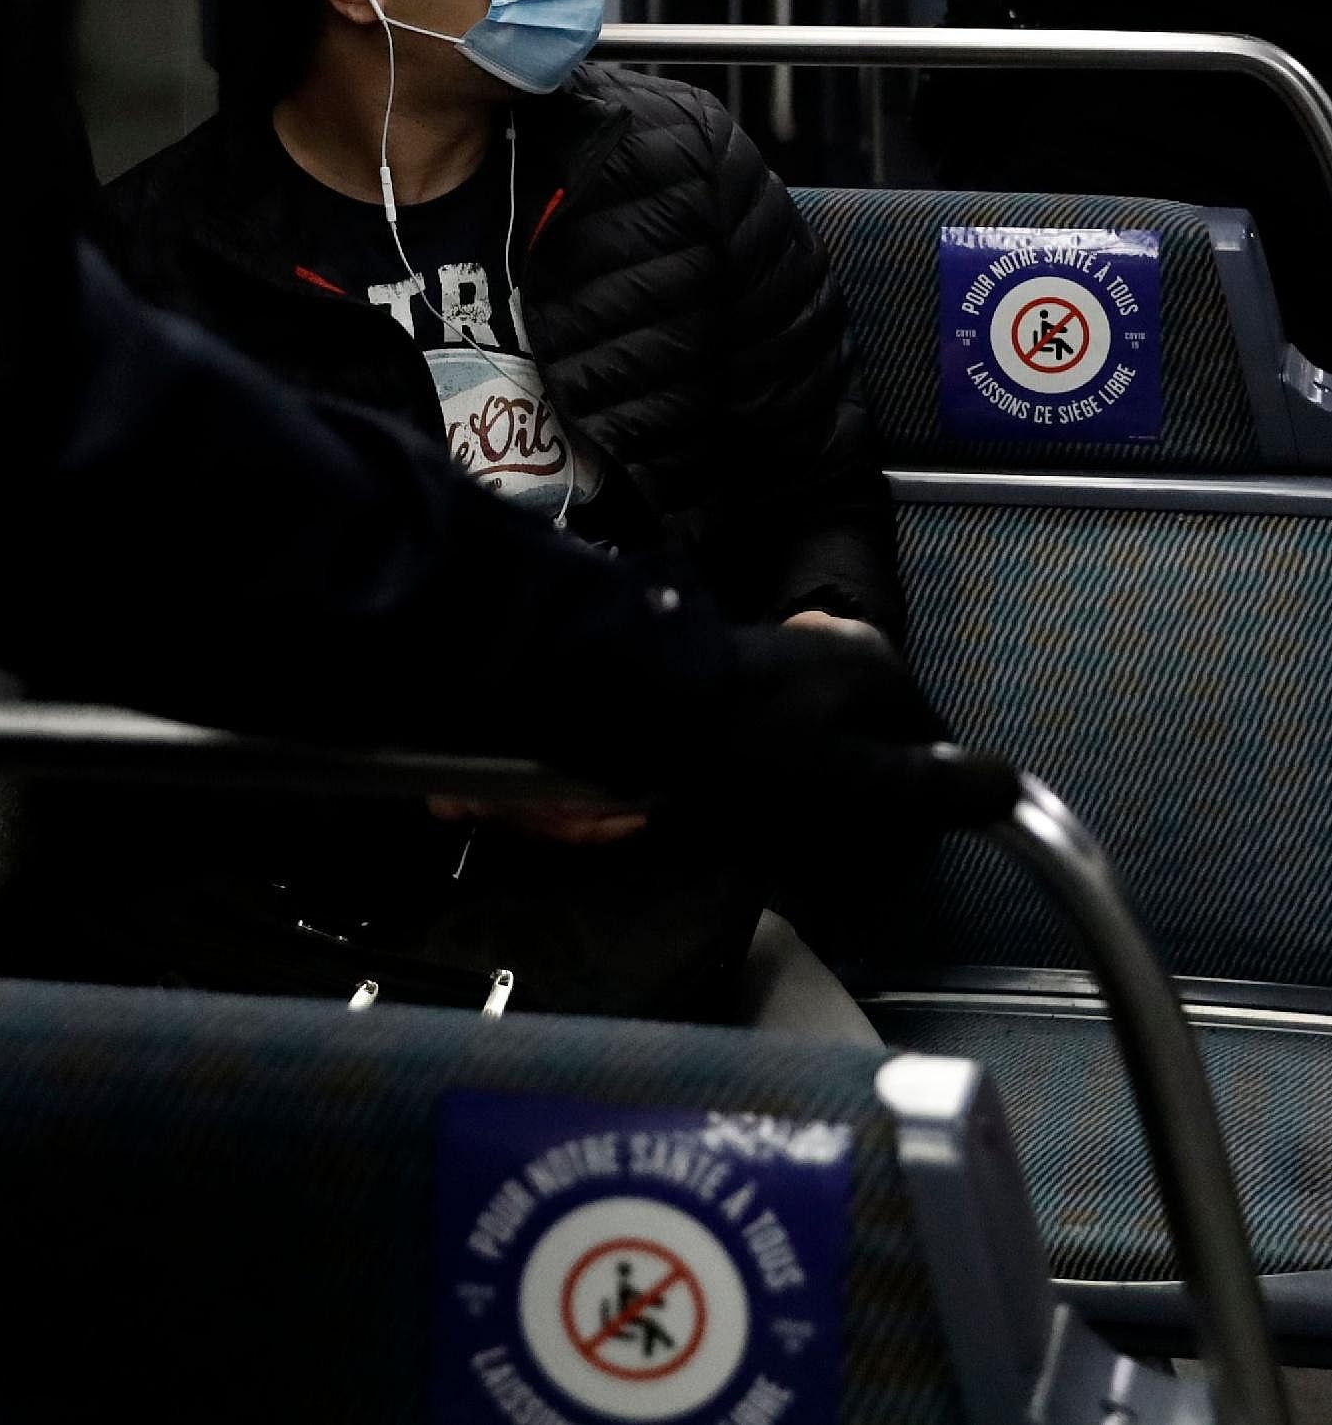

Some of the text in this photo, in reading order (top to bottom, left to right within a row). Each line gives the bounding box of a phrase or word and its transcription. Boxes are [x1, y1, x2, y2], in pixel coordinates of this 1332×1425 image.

[961, 245, 1140, 317] POUR NOTRE SANTÉ À TOUS
[966, 361, 1137, 425] LAISSONS CE SIÈGE LIBRE
[466, 1177, 536, 1262] POUR
[524, 1131, 621, 1199] NOTRE
[740, 1207, 806, 1294] TOUS
